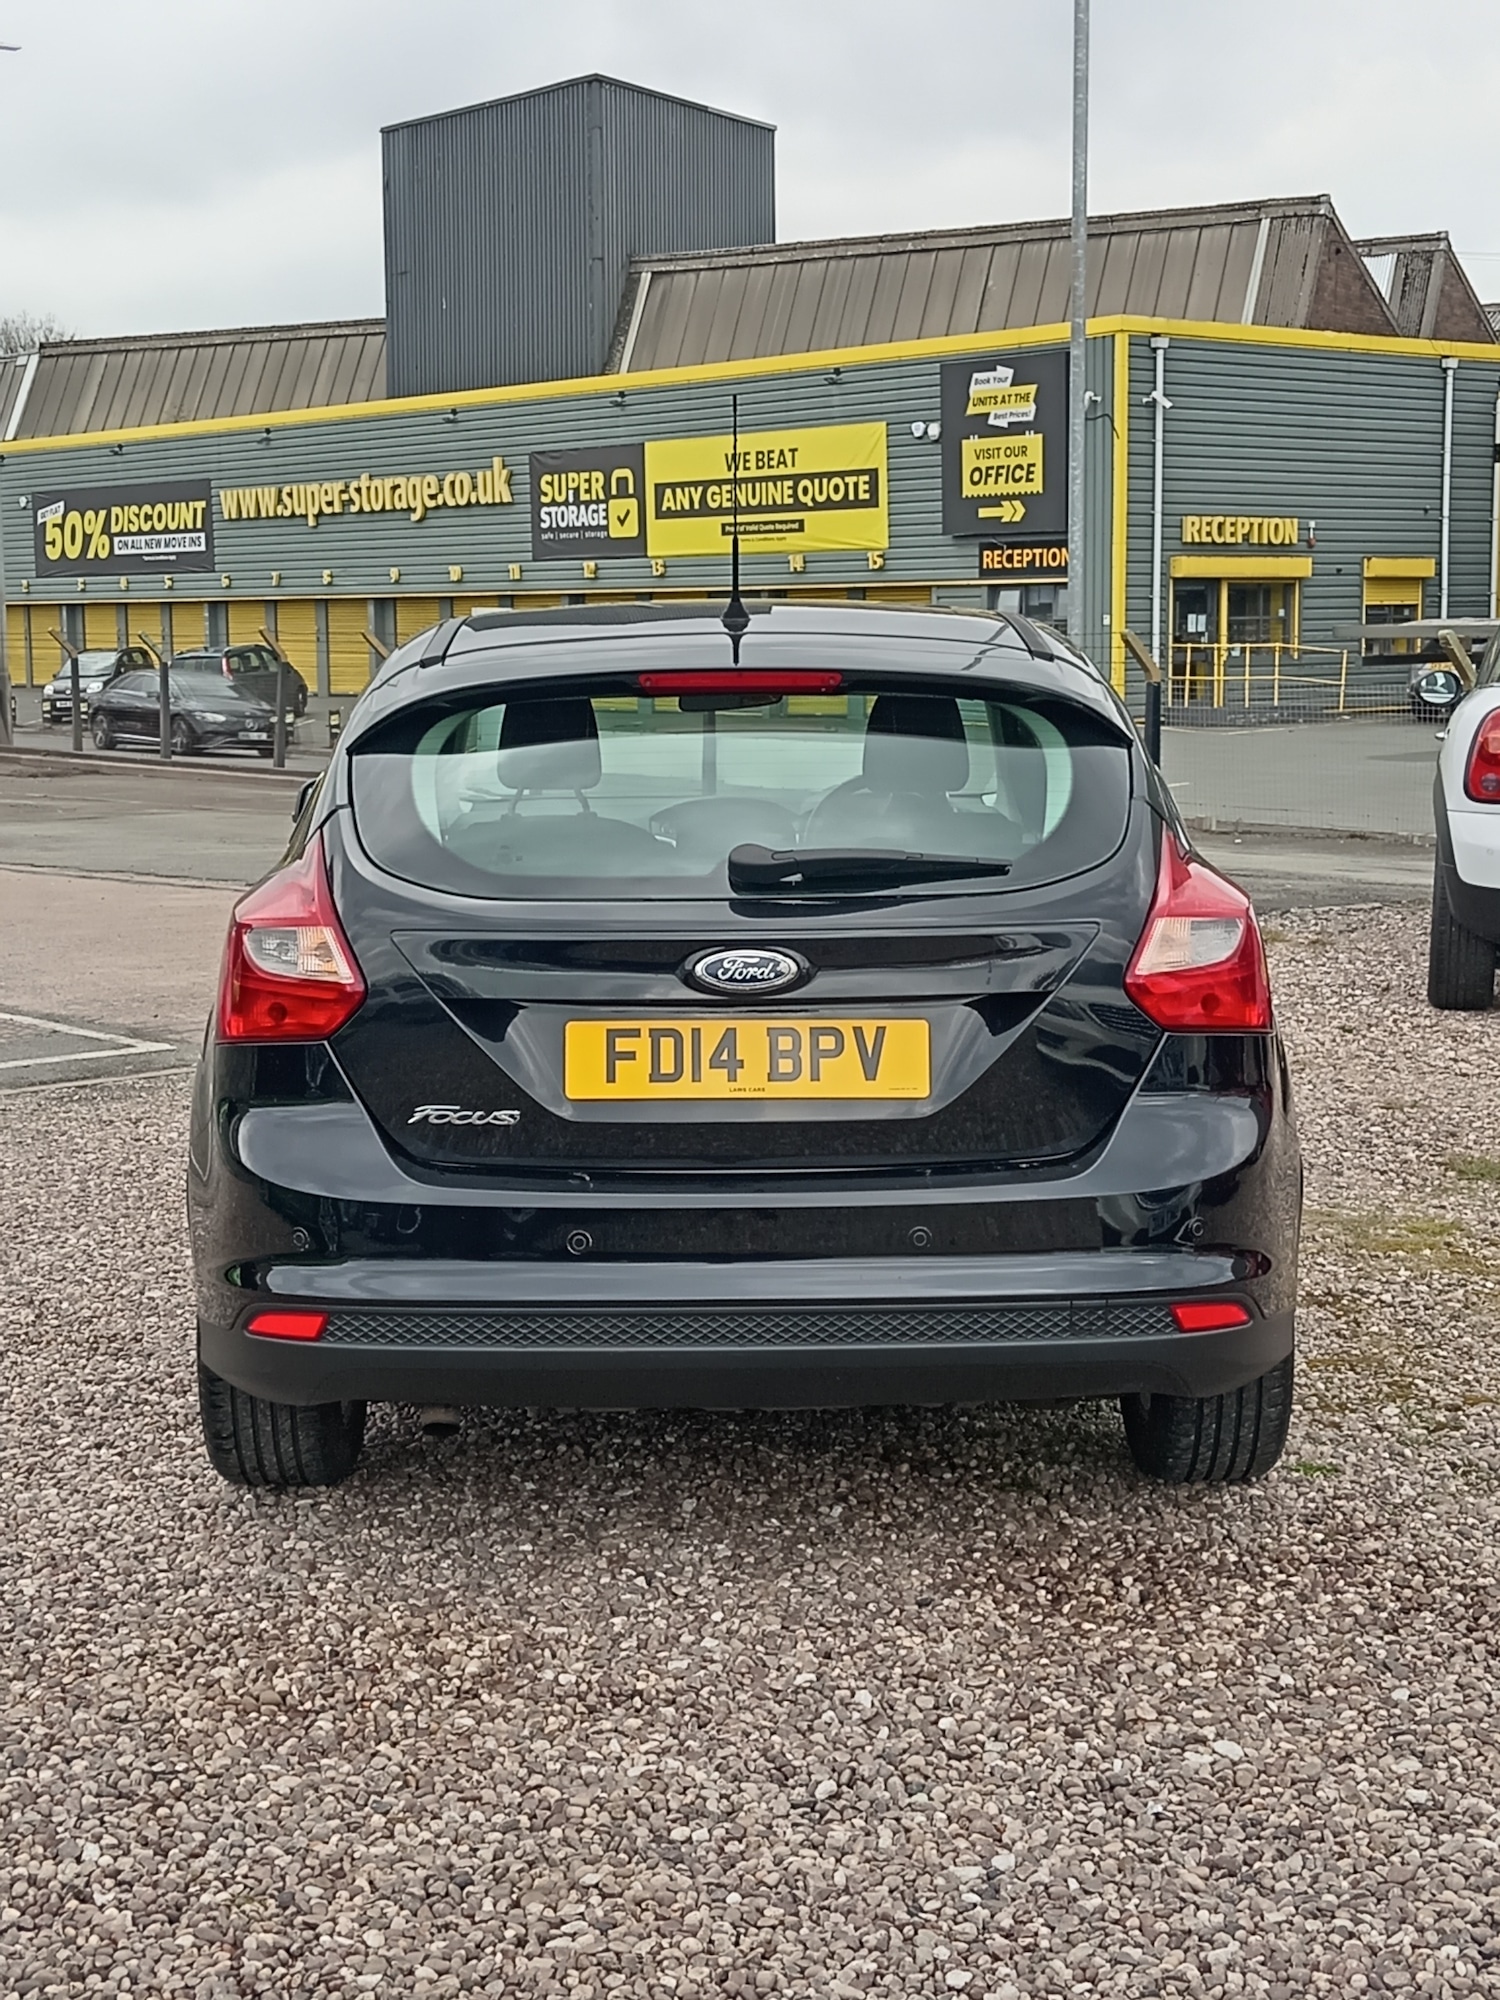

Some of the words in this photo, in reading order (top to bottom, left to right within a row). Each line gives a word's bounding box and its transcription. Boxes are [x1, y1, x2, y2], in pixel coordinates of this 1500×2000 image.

[974, 378, 990, 386] Book
[992, 376, 1009, 384] Your
[972, 395, 998, 408] UNITS
[1000, 394, 1014, 406] AT
[1014, 392, 1032, 404] THE
[994, 412, 1008, 420] Best
[1009, 410, 1032, 418] Prices!
[724, 451, 751, 472] WE
[755, 448, 798, 470] BEAT
[974, 447, 1002, 460] VISIT
[1004, 445, 1028, 458] OUR
[969, 462, 1036, 486] OFFICE
[219, 456, 514, 528] www.super-storage.co.uk
[540, 470, 606, 504] SUPER
[661, 486, 704, 512] ANY
[706, 480, 794, 510] GENUINE
[797, 474, 871, 508] QUOTE
[110, 500, 206, 534] DISCOUNT
[540, 503, 608, 528] STORAGE
[45, 510, 110, 560] 50%
[541, 531, 554, 540] safe
[560, 532, 579, 540] secure
[584, 530, 608, 540] storage
[1182, 515, 1298, 545] RECEPTION
[117, 539, 129, 550] ON
[130, 538, 142, 550] ALL
[144, 538, 162, 550] NEW
[164, 536, 186, 548] MOVE
[188, 536, 202, 548] INS
[866, 551, 886, 570] 15
[982, 547, 1070, 570] RECEPTION
[389, 567, 400, 584] 9
[718, 956, 775, 980] Ford
[606, 1027, 745, 1084] FD14
[766, 1026, 887, 1082] BPV
